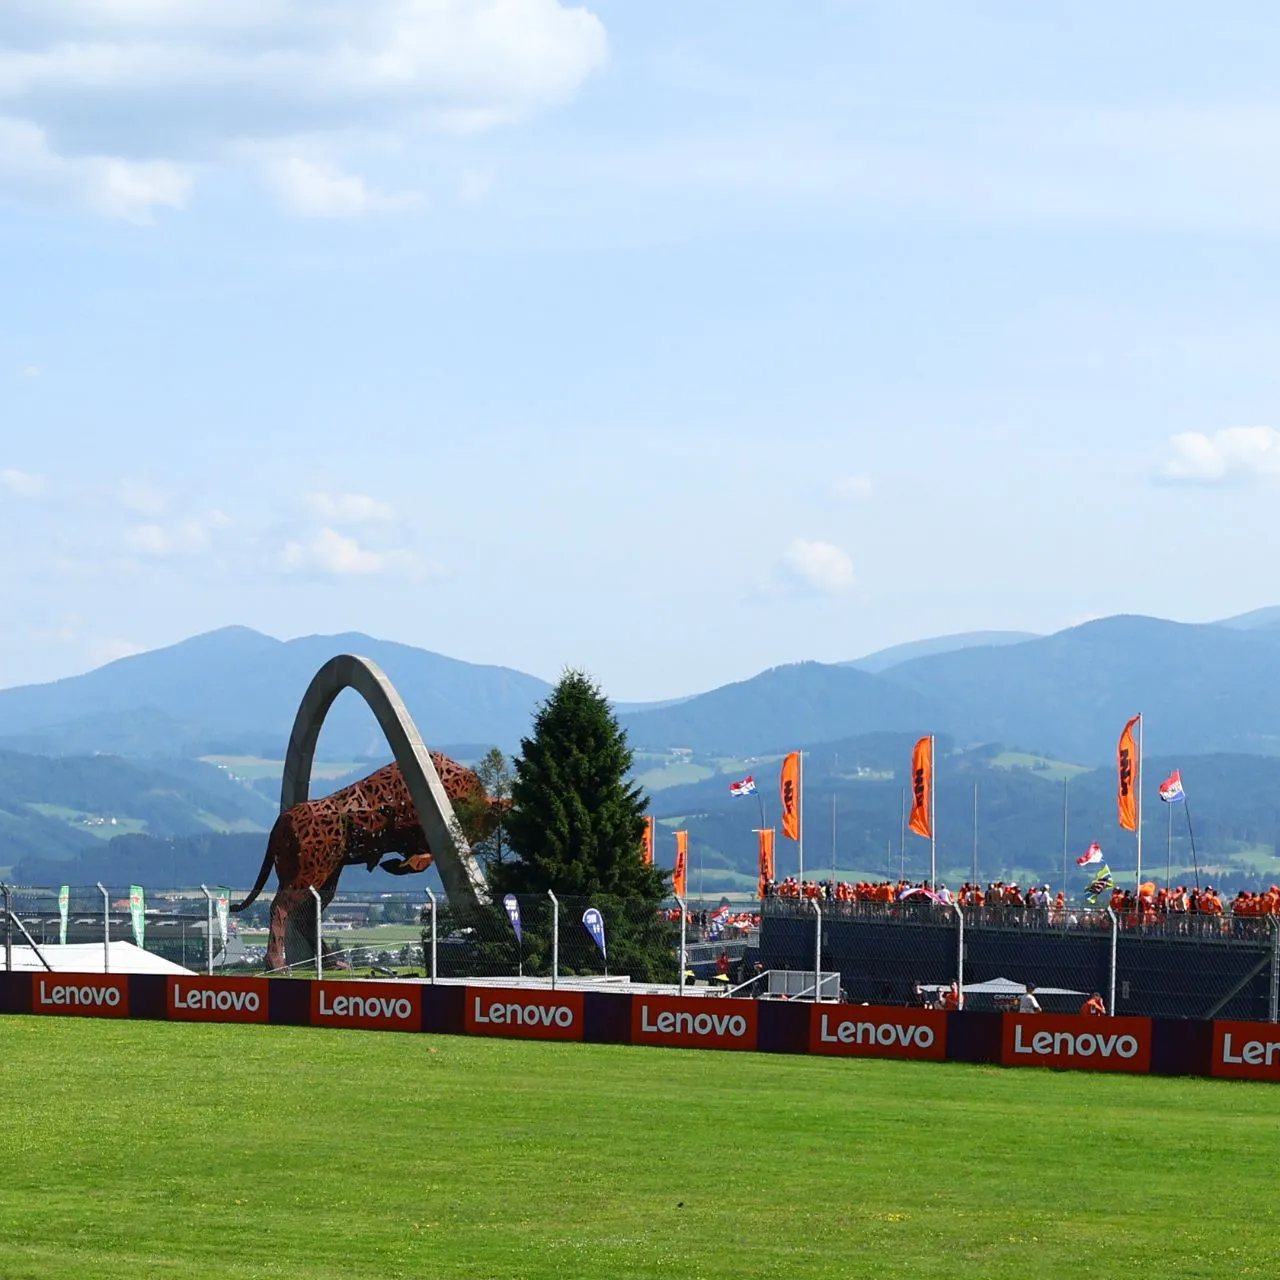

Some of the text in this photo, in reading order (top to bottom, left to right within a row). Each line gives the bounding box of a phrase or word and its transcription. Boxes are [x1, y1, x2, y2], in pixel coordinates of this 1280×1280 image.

[41, 981, 119, 1005] Lenovo
[175, 984, 259, 1011] Lenovo
[320, 990, 411, 1018] Lenovo
[475, 997, 573, 1027] Lenovo
[642, 1005, 746, 1036] Lenovo
[822, 1015, 933, 1047] Lenovo
[1015, 1025, 1137, 1057] Lenovo
